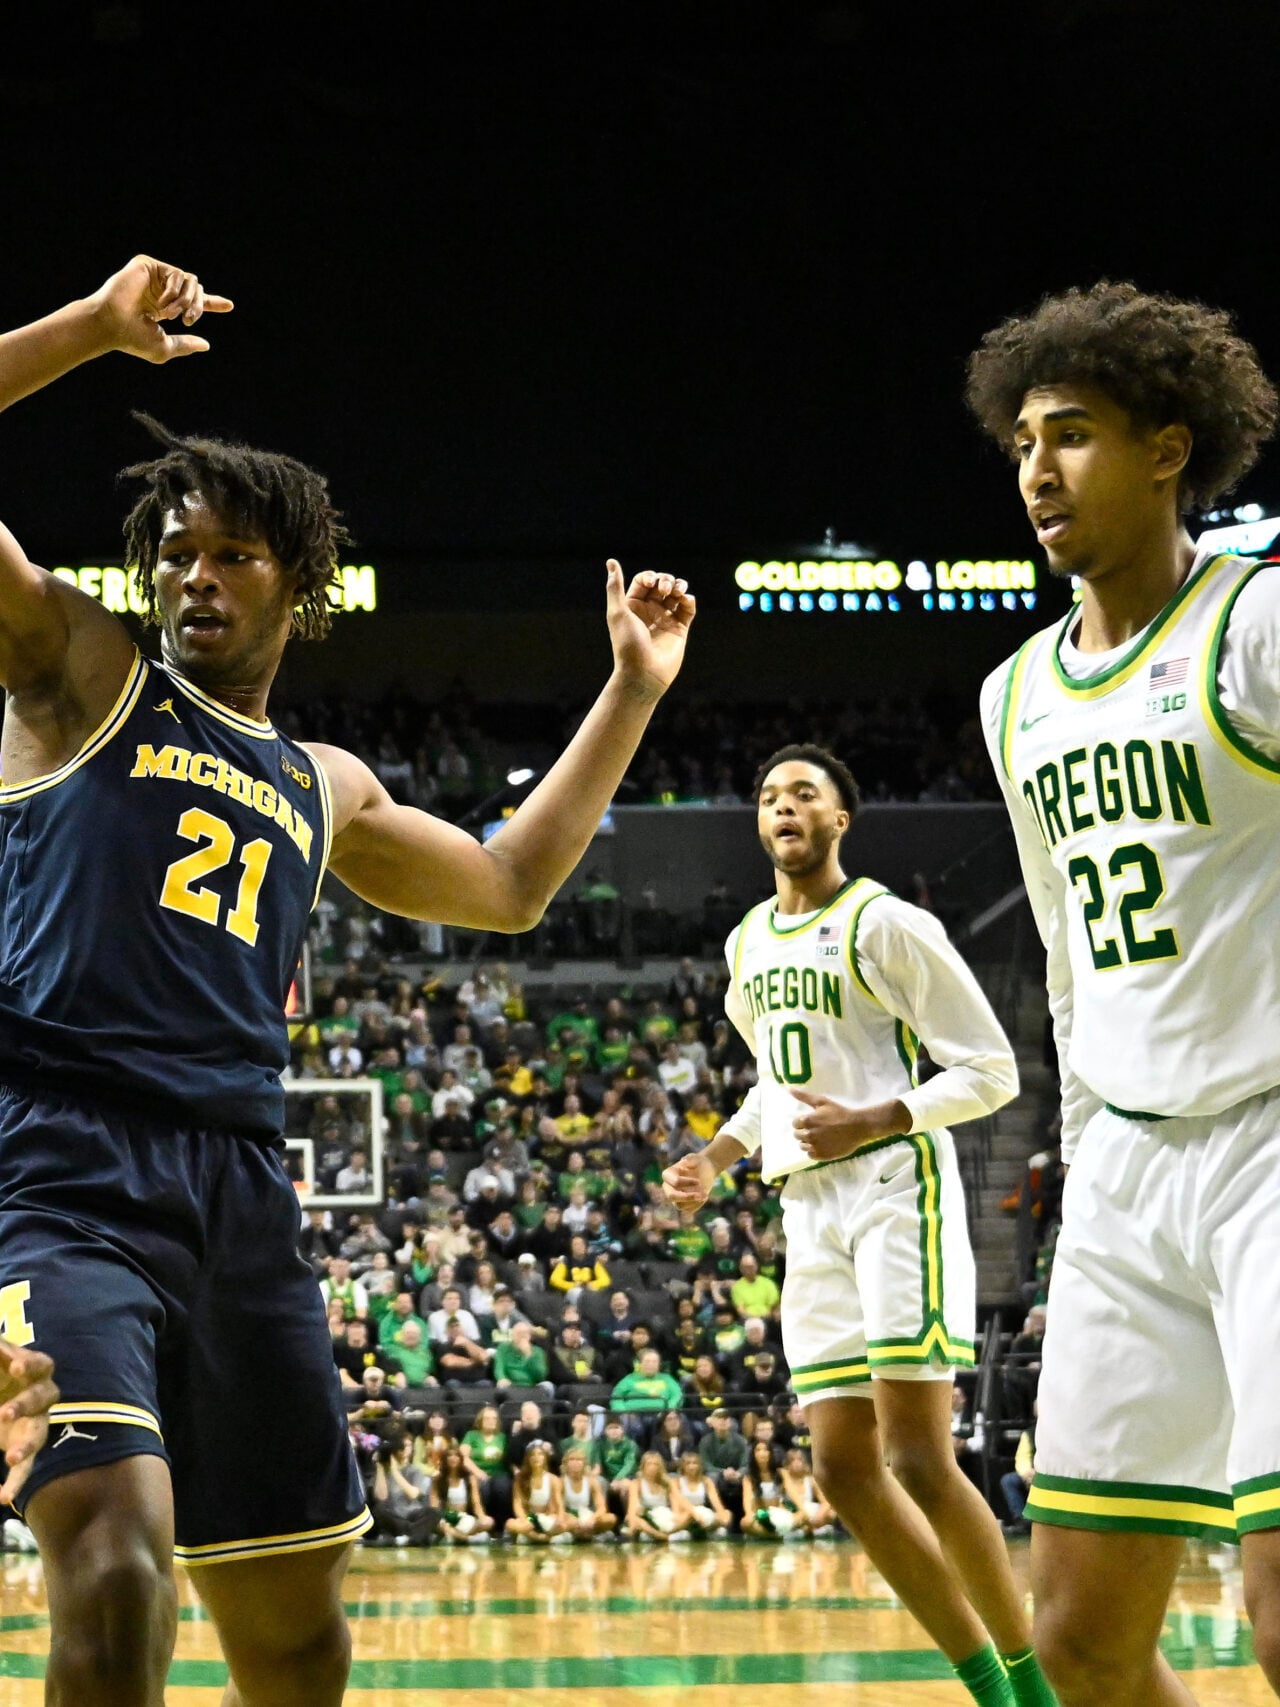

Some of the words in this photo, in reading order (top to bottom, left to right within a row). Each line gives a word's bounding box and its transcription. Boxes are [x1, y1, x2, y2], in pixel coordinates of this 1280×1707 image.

[734, 560, 902, 591] GOLDBERG
[905, 559, 933, 591] &
[935, 560, 1037, 590] LOREN
[129, 744, 314, 865] MICHIGAN
[159, 806, 273, 948] 21
[1068, 842, 1180, 972] 22
